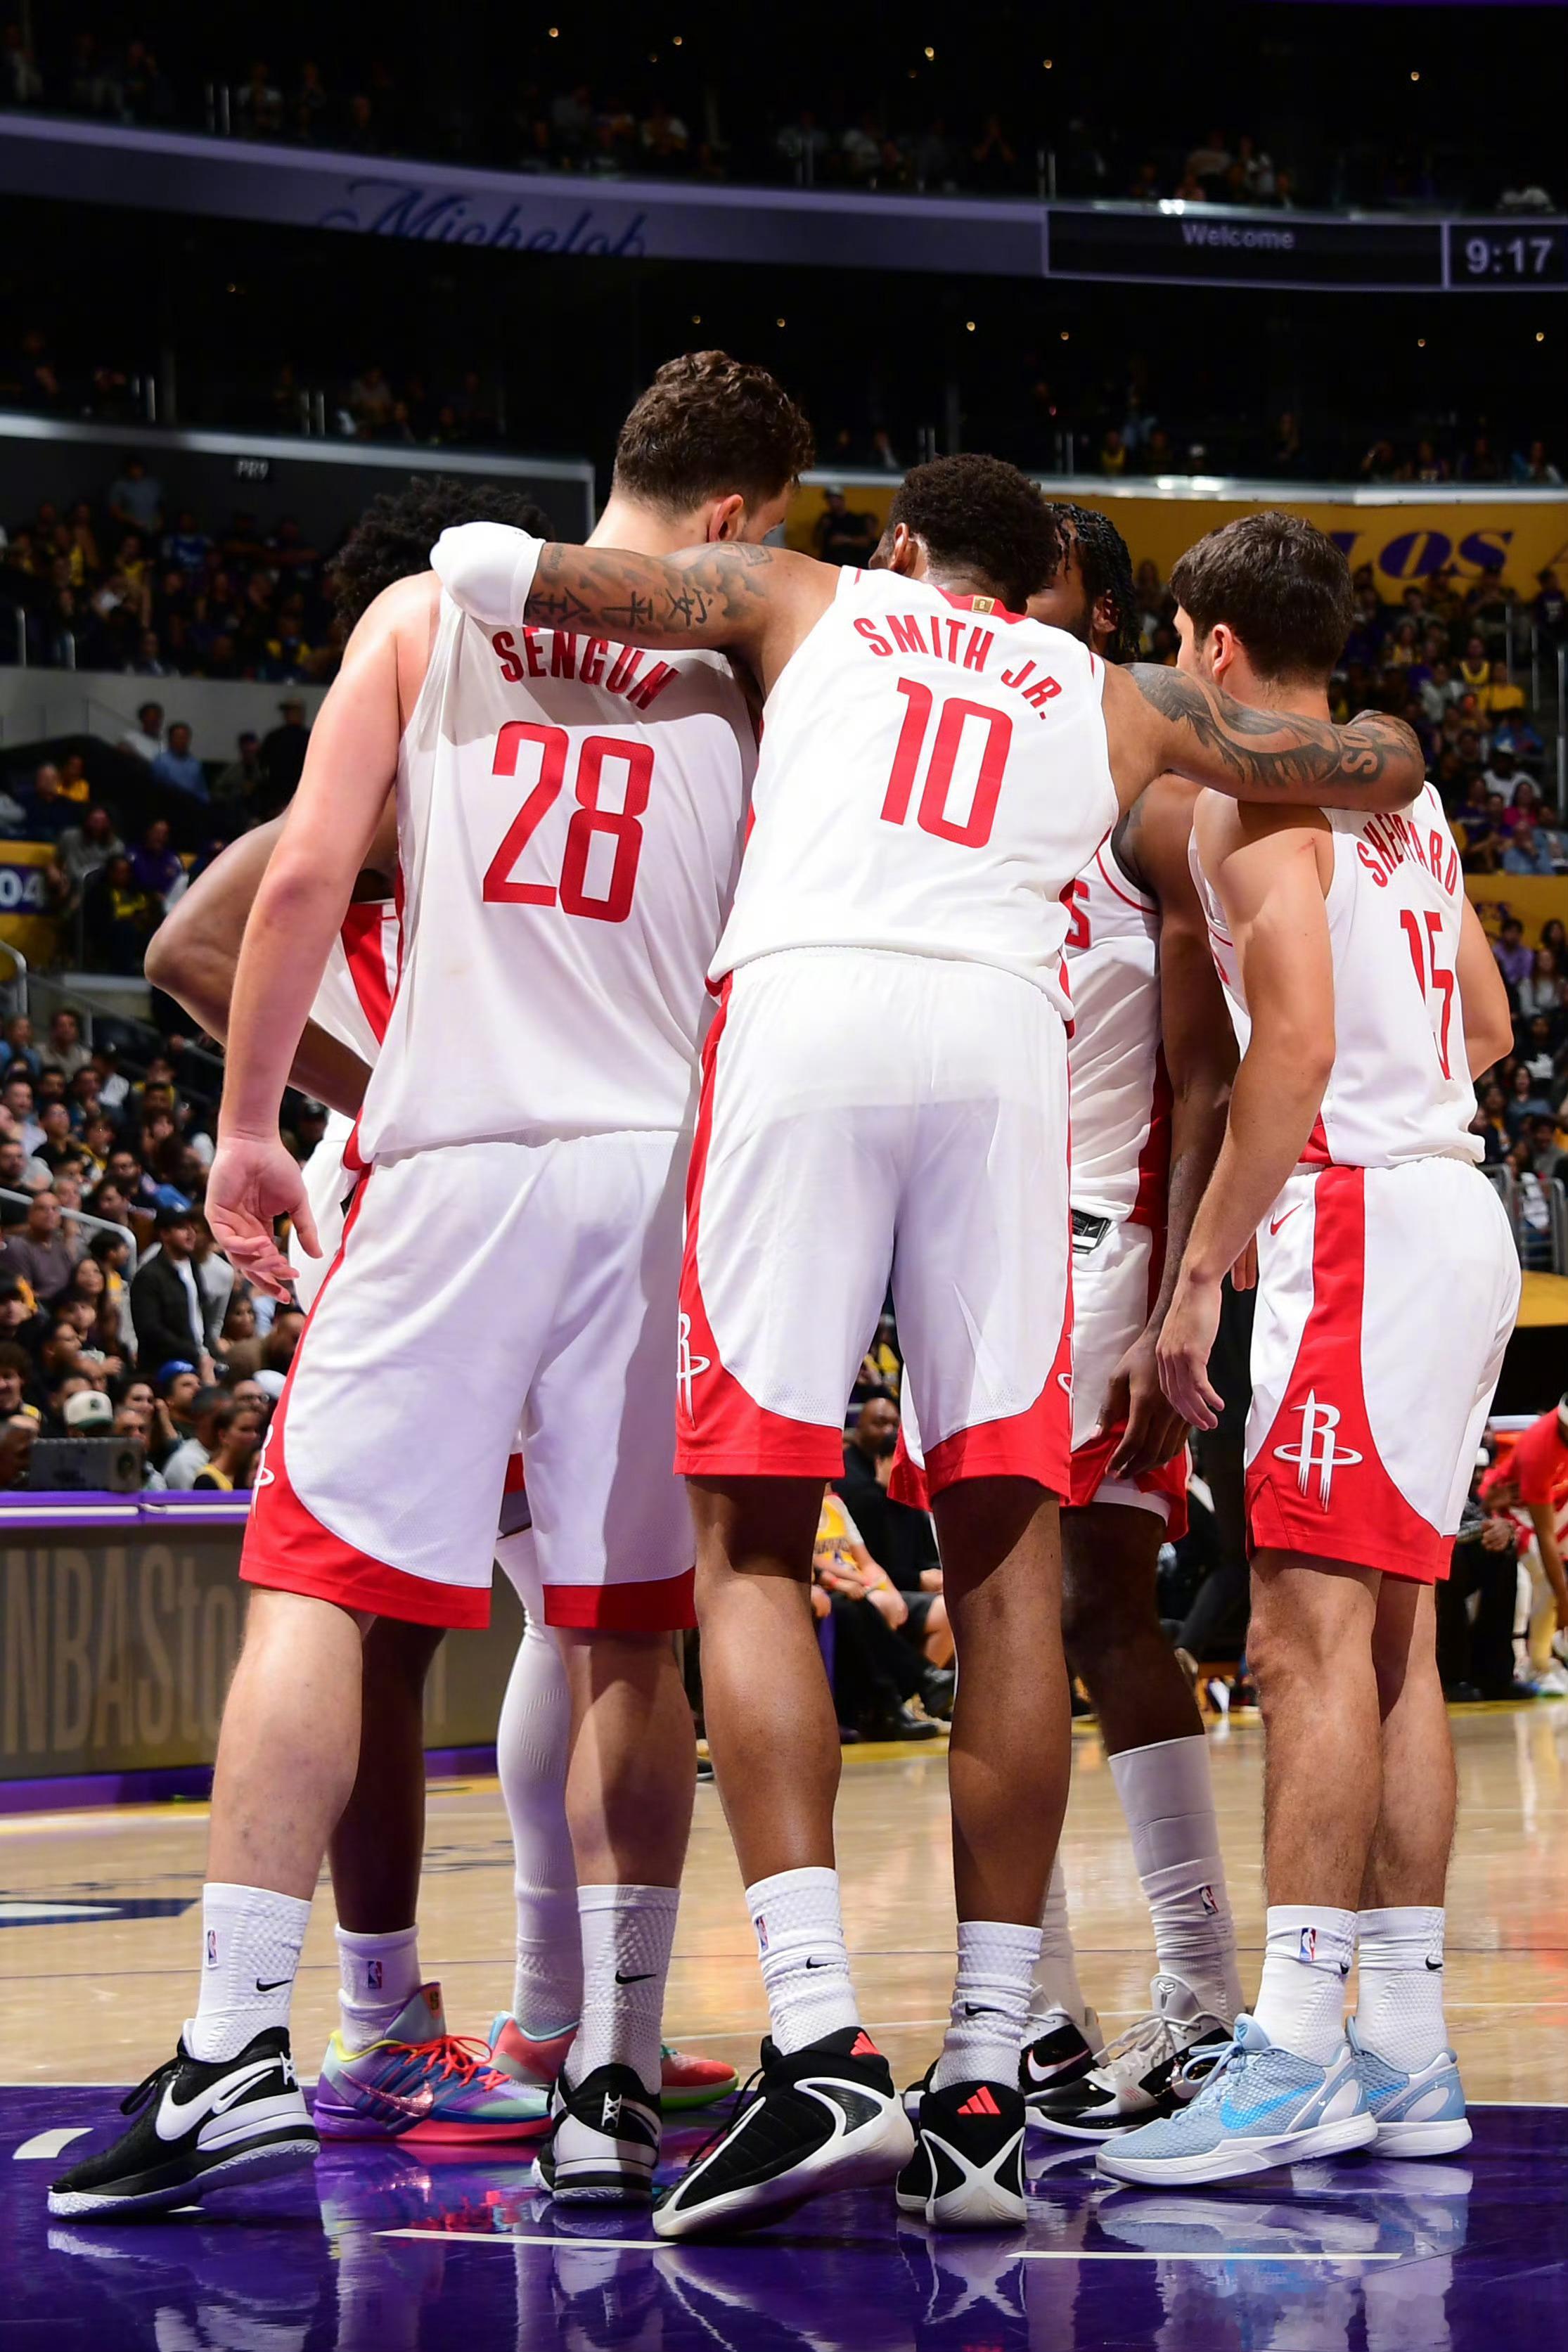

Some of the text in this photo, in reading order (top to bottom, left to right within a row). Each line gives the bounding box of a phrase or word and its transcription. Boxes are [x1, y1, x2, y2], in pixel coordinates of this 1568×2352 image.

[1183, 221, 1295, 249] Welcome
[1465, 237, 1553, 274] 9:17
[492, 626, 681, 711] SENGUN
[853, 615, 1062, 721] SMITH JR.
[880, 676, 1013, 849] 10
[483, 720, 655, 923] 28
[1400, 908, 1455, 1081] 15
